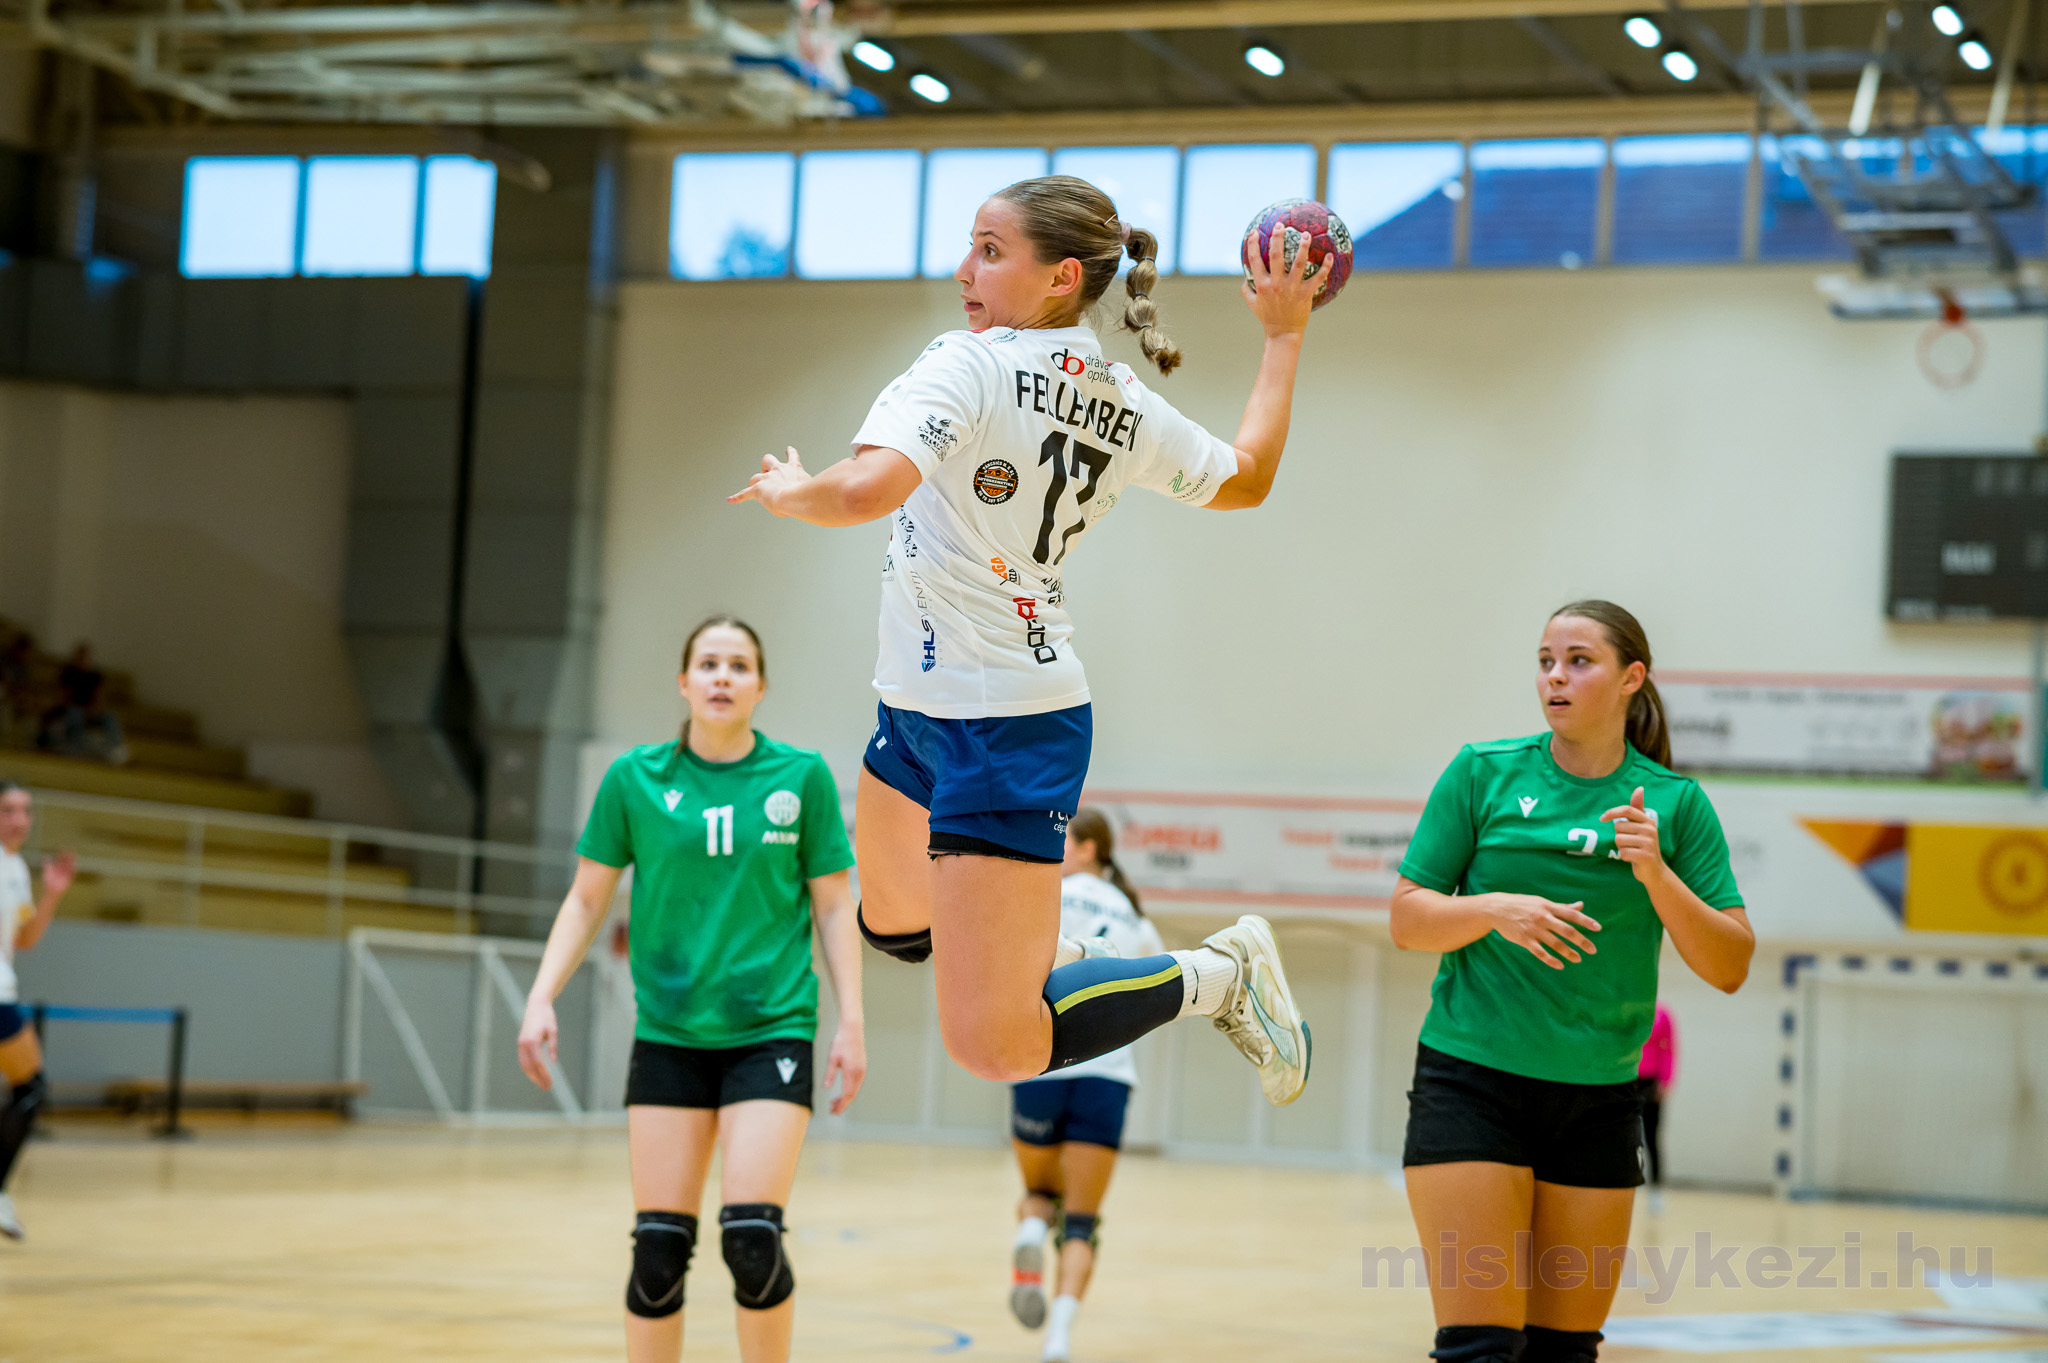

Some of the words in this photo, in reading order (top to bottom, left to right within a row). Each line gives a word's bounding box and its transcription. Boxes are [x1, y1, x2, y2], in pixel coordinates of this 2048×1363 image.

[1087, 370, 1116, 386] optika
[1032, 430, 1113, 566] 17
[702, 804, 734, 857] 11
